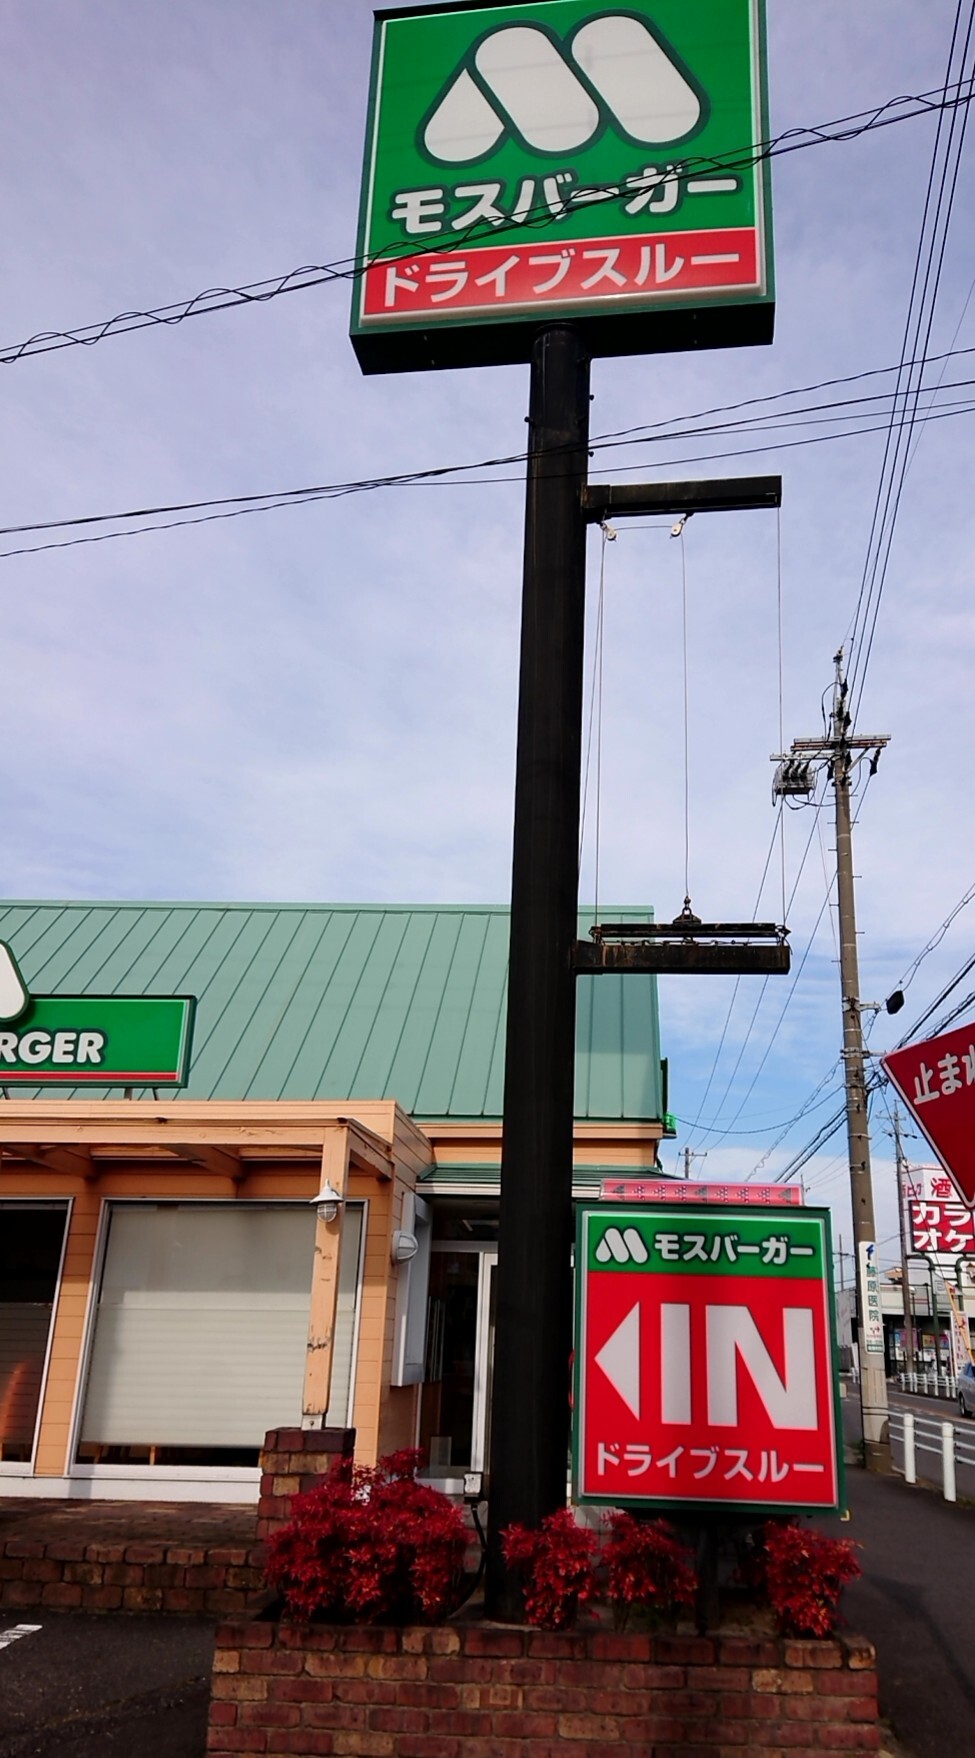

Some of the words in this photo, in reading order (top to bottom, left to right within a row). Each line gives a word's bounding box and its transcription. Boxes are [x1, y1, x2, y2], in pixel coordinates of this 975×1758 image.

[392, 165, 738, 234] モスバーガー
[384, 243, 741, 307] ドライブスルー
[912, 1202, 971, 1226] カラ
[655, 1234, 814, 1264] モスバーガー
[913, 1228, 974, 1252] オケ
[660, 1303, 818, 1431] IN
[597, 1442, 824, 1482] ドライブスルー
